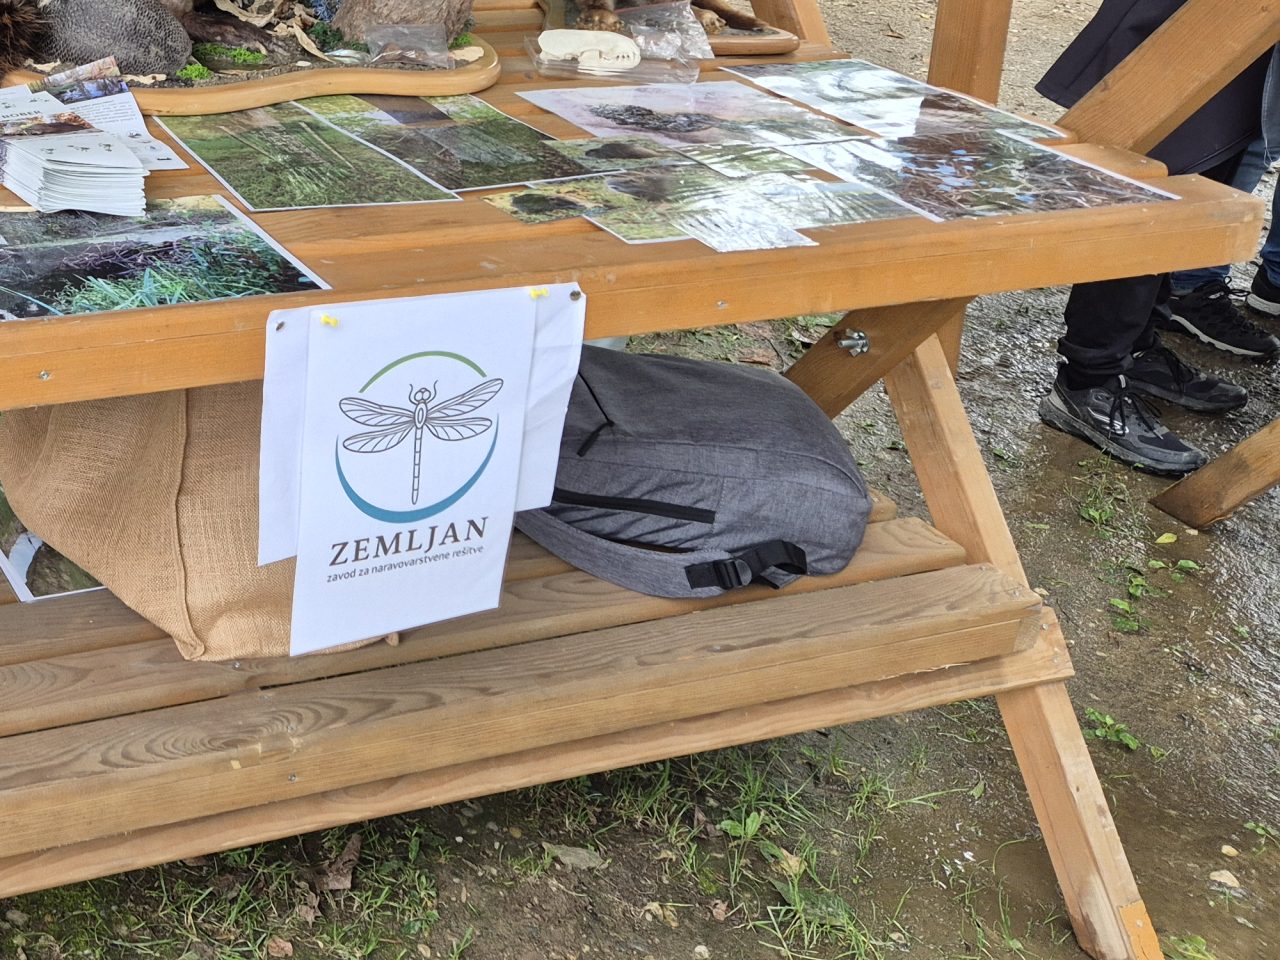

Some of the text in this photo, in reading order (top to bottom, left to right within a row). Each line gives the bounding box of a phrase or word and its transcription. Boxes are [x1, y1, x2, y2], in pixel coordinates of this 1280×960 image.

[329, 516, 489, 566] ZEMLJAN
[326, 545, 484, 583] zavod za naravovarstvene rešitve
